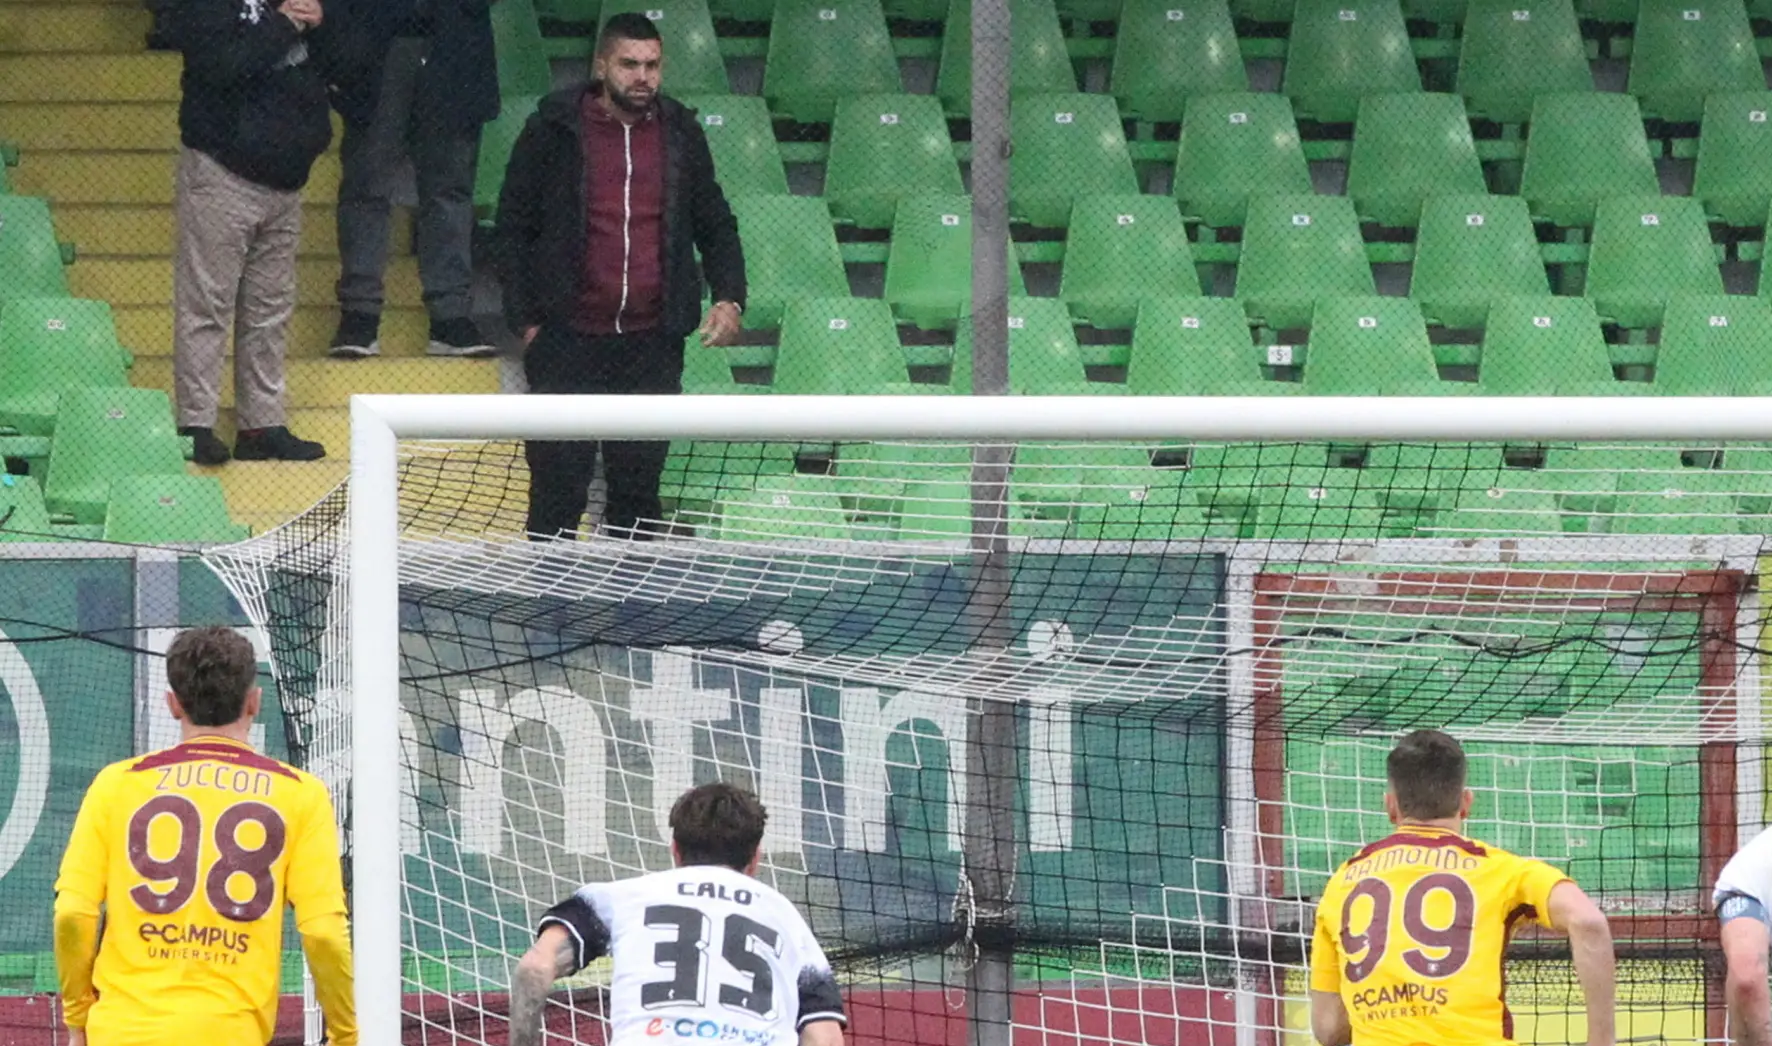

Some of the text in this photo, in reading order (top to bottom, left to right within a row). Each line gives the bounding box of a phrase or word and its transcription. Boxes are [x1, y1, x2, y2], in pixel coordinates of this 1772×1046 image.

[155, 758, 272, 798] ZUCCON
[127, 793, 286, 923] 98
[1343, 847, 1479, 884] RAIMONDO
[641, 904, 784, 1014] 35
[1339, 871, 1475, 983] 99
